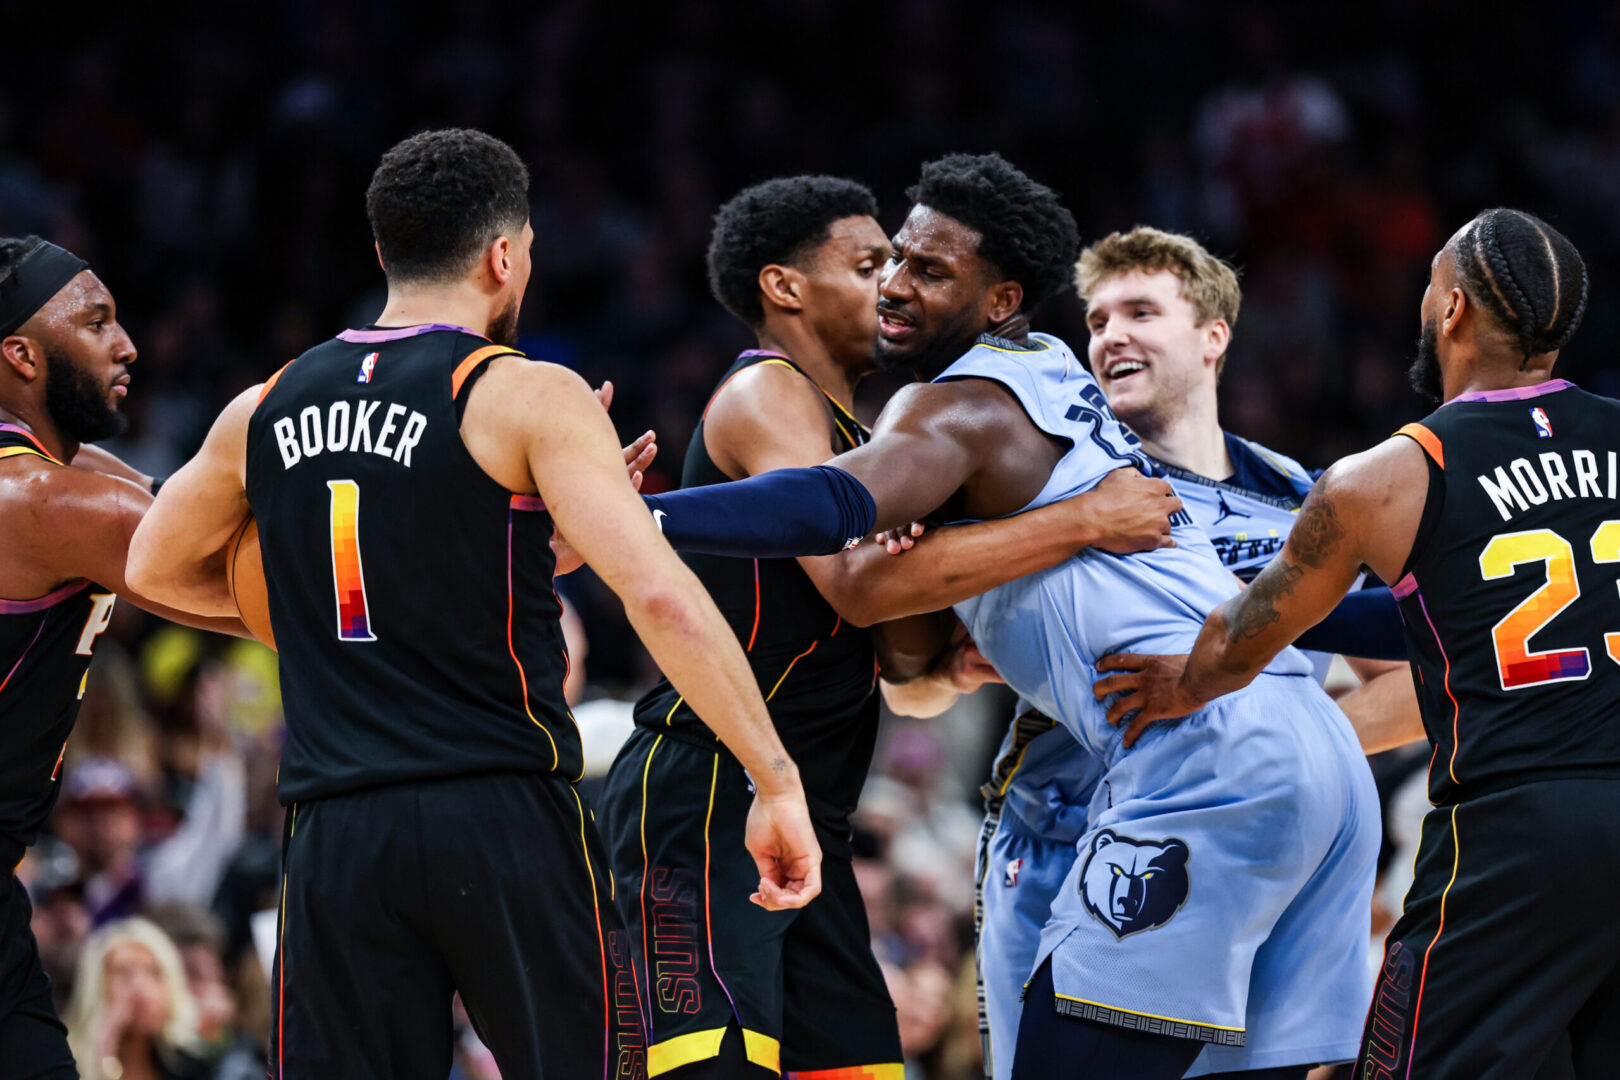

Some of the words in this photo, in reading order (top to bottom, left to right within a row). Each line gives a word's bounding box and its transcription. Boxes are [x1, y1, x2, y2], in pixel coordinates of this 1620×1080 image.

[273, 399, 428, 471] BOOKER
[326, 479, 378, 642] 1
[651, 867, 702, 1015] SUNS
